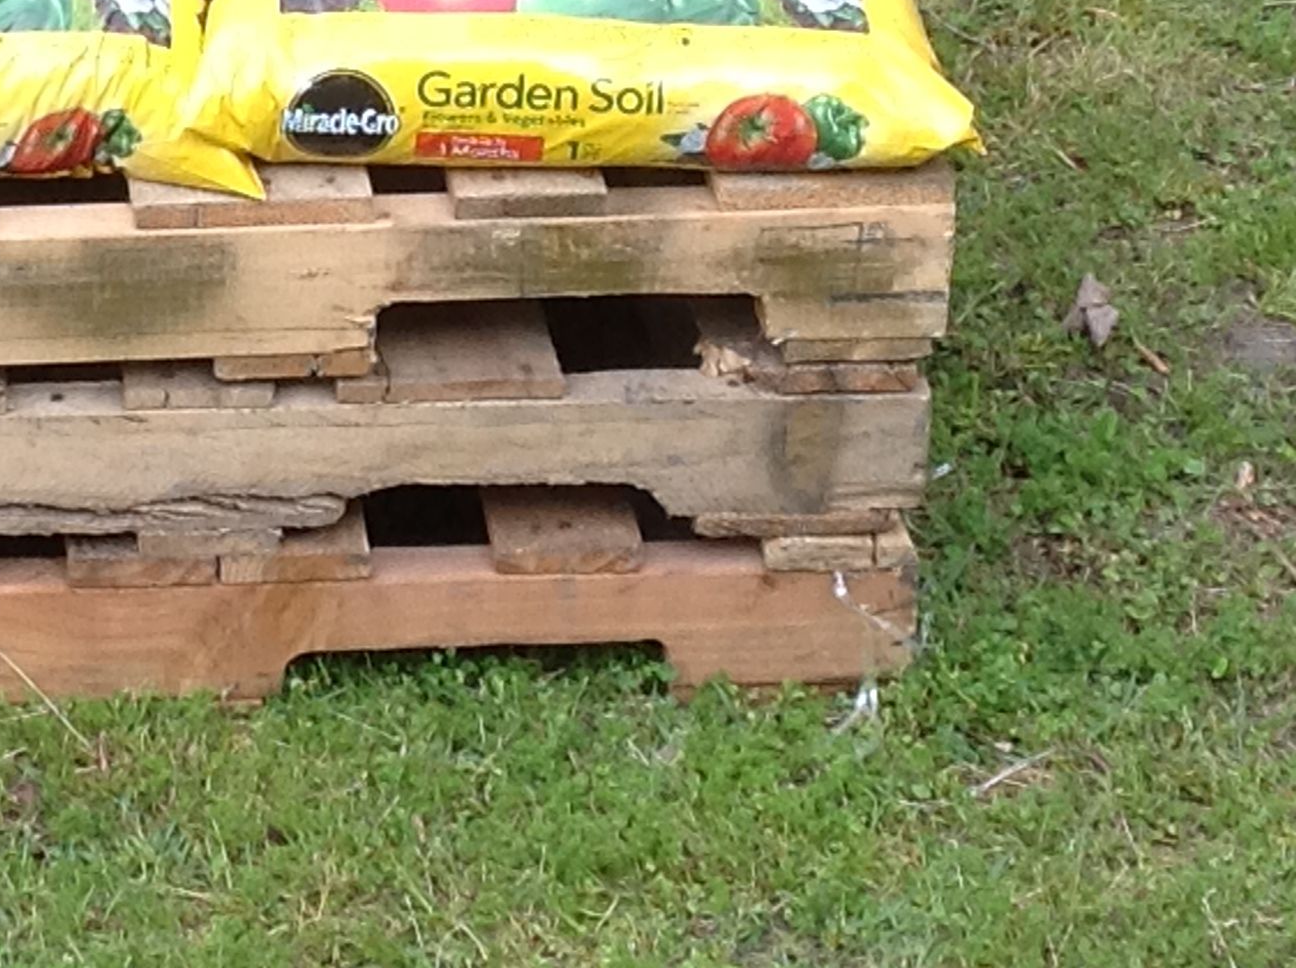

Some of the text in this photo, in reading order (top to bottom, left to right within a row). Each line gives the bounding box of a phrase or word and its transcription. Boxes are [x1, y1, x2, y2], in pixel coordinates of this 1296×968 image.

[417, 70, 664, 116] Garden Soil
[281, 107, 400, 135] Miracle-Gro
